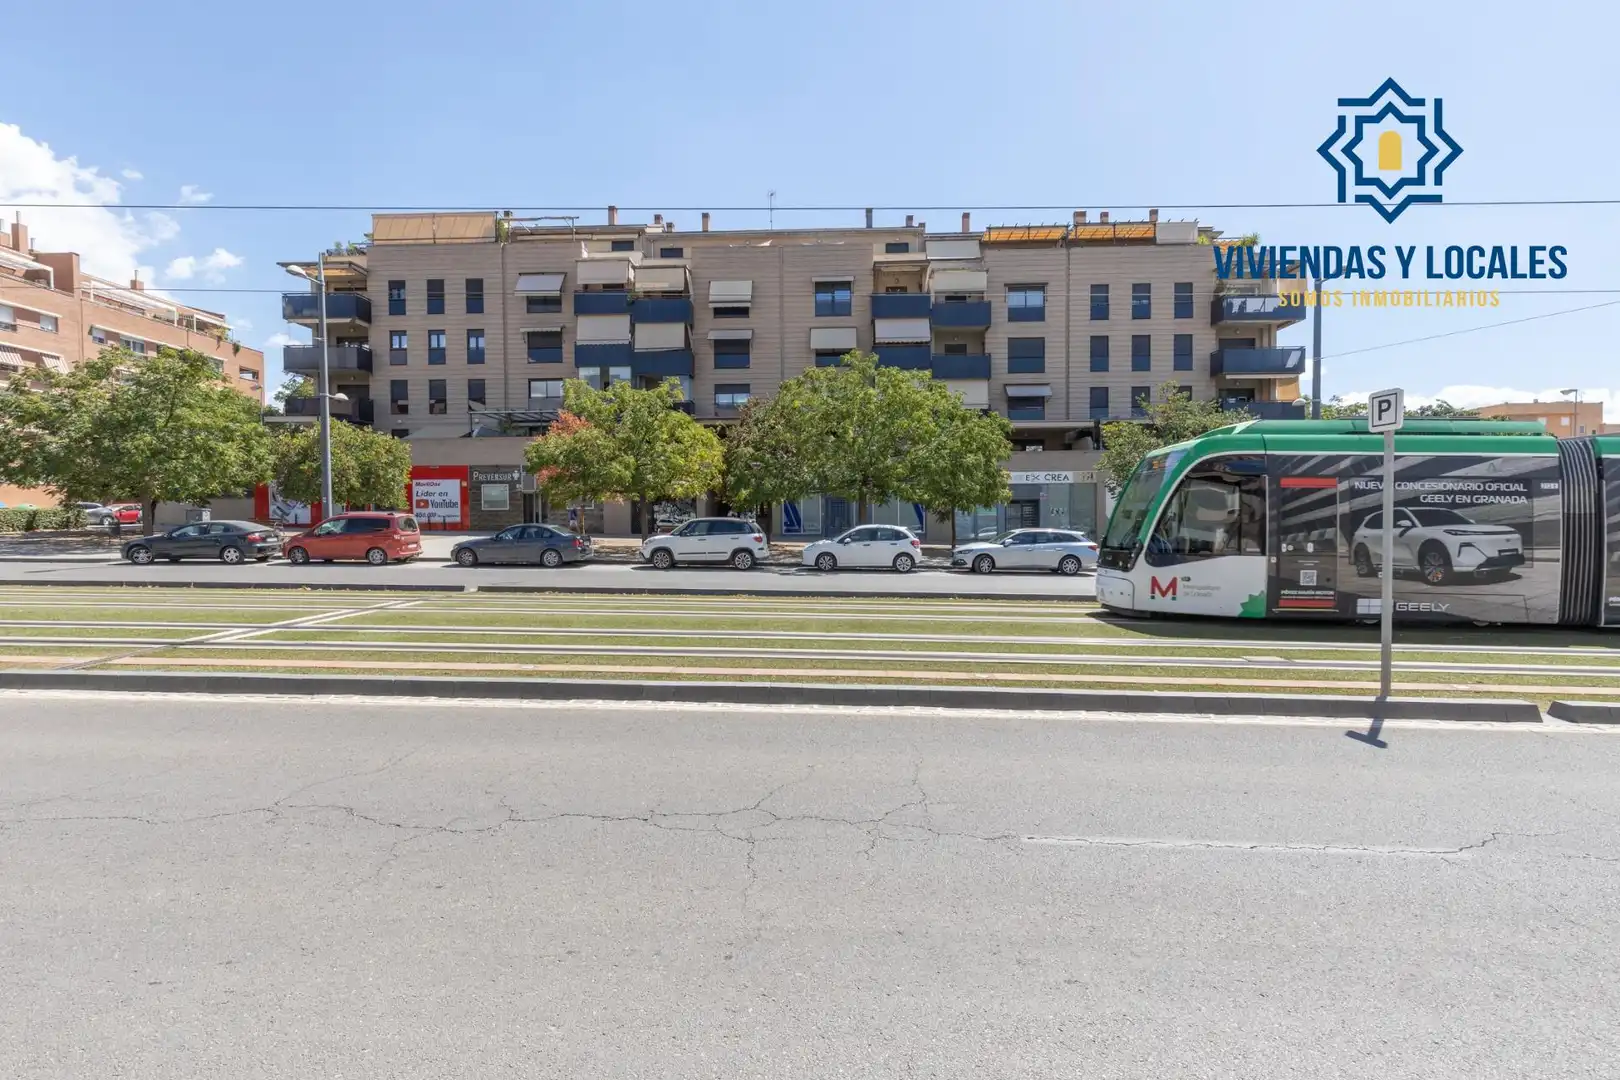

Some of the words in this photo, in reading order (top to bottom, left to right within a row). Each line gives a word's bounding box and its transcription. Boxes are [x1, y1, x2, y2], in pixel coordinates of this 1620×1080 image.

[1378, 399, 1392, 421] P
[1354, 481, 1394, 490] NUEV
[1395, 481, 1484, 491] CONCESIONARIO
[1489, 482, 1528, 492] OFICIAL
[430, 499, 459, 509] YouTube
[1420, 494, 1453, 503] GEELY
[1456, 494, 1470, 504] EN
[1472, 494, 1528, 504] GRANADA
[1396, 602, 1450, 612] GEELY
